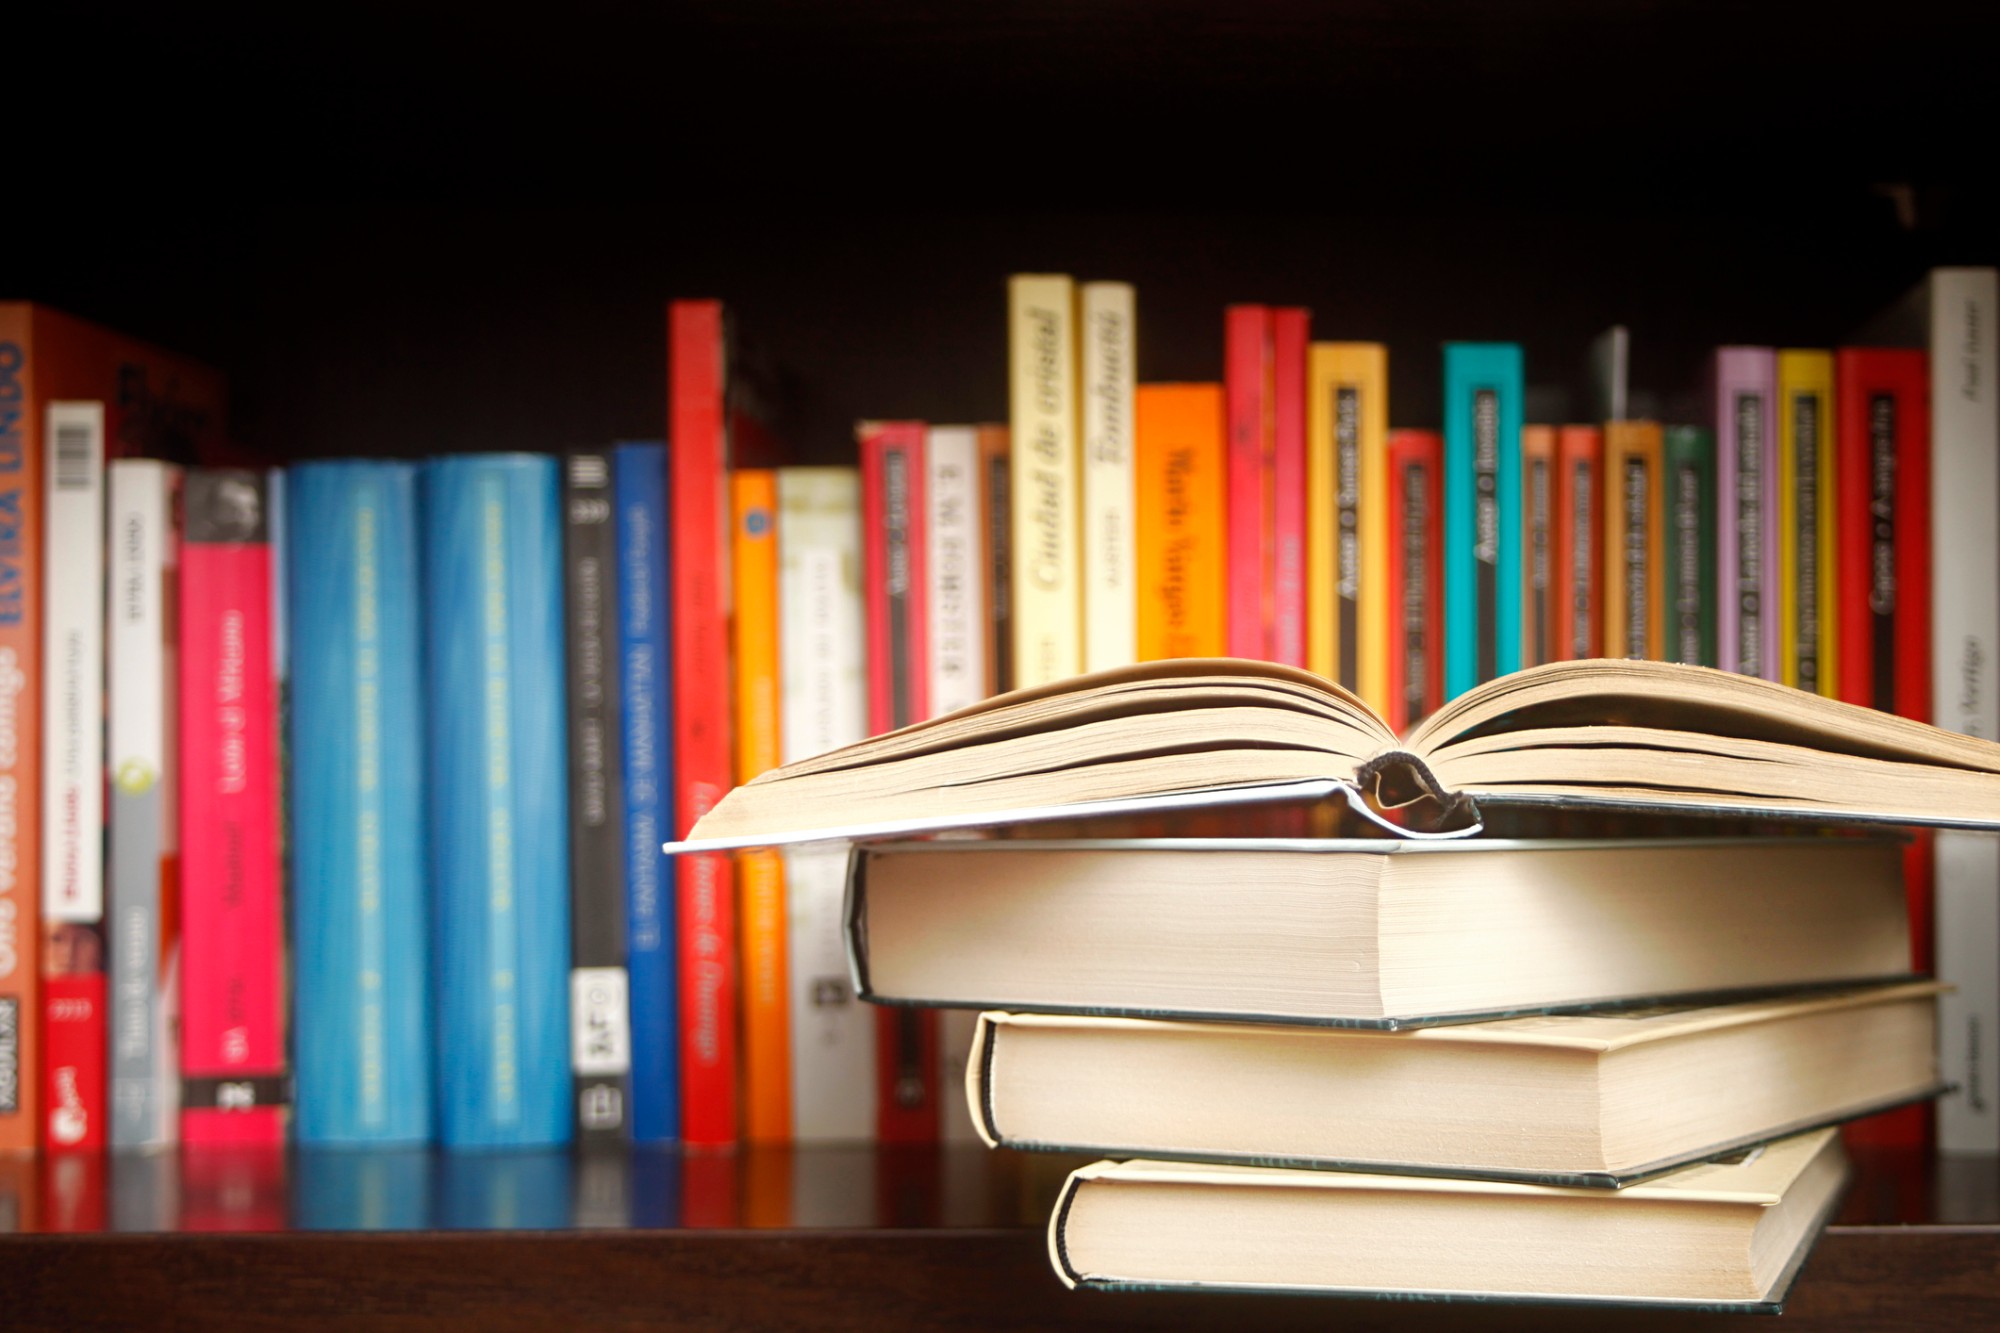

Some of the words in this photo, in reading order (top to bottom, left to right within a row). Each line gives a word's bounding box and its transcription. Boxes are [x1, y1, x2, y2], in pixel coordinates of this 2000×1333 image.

[0, 341, 25, 473] LINDO
[1024, 303, 1060, 414] cristal
[1026, 418, 1061, 464] de
[0, 486, 24, 625] ELVIRA
[1028, 466, 1064, 591] Ciudad
